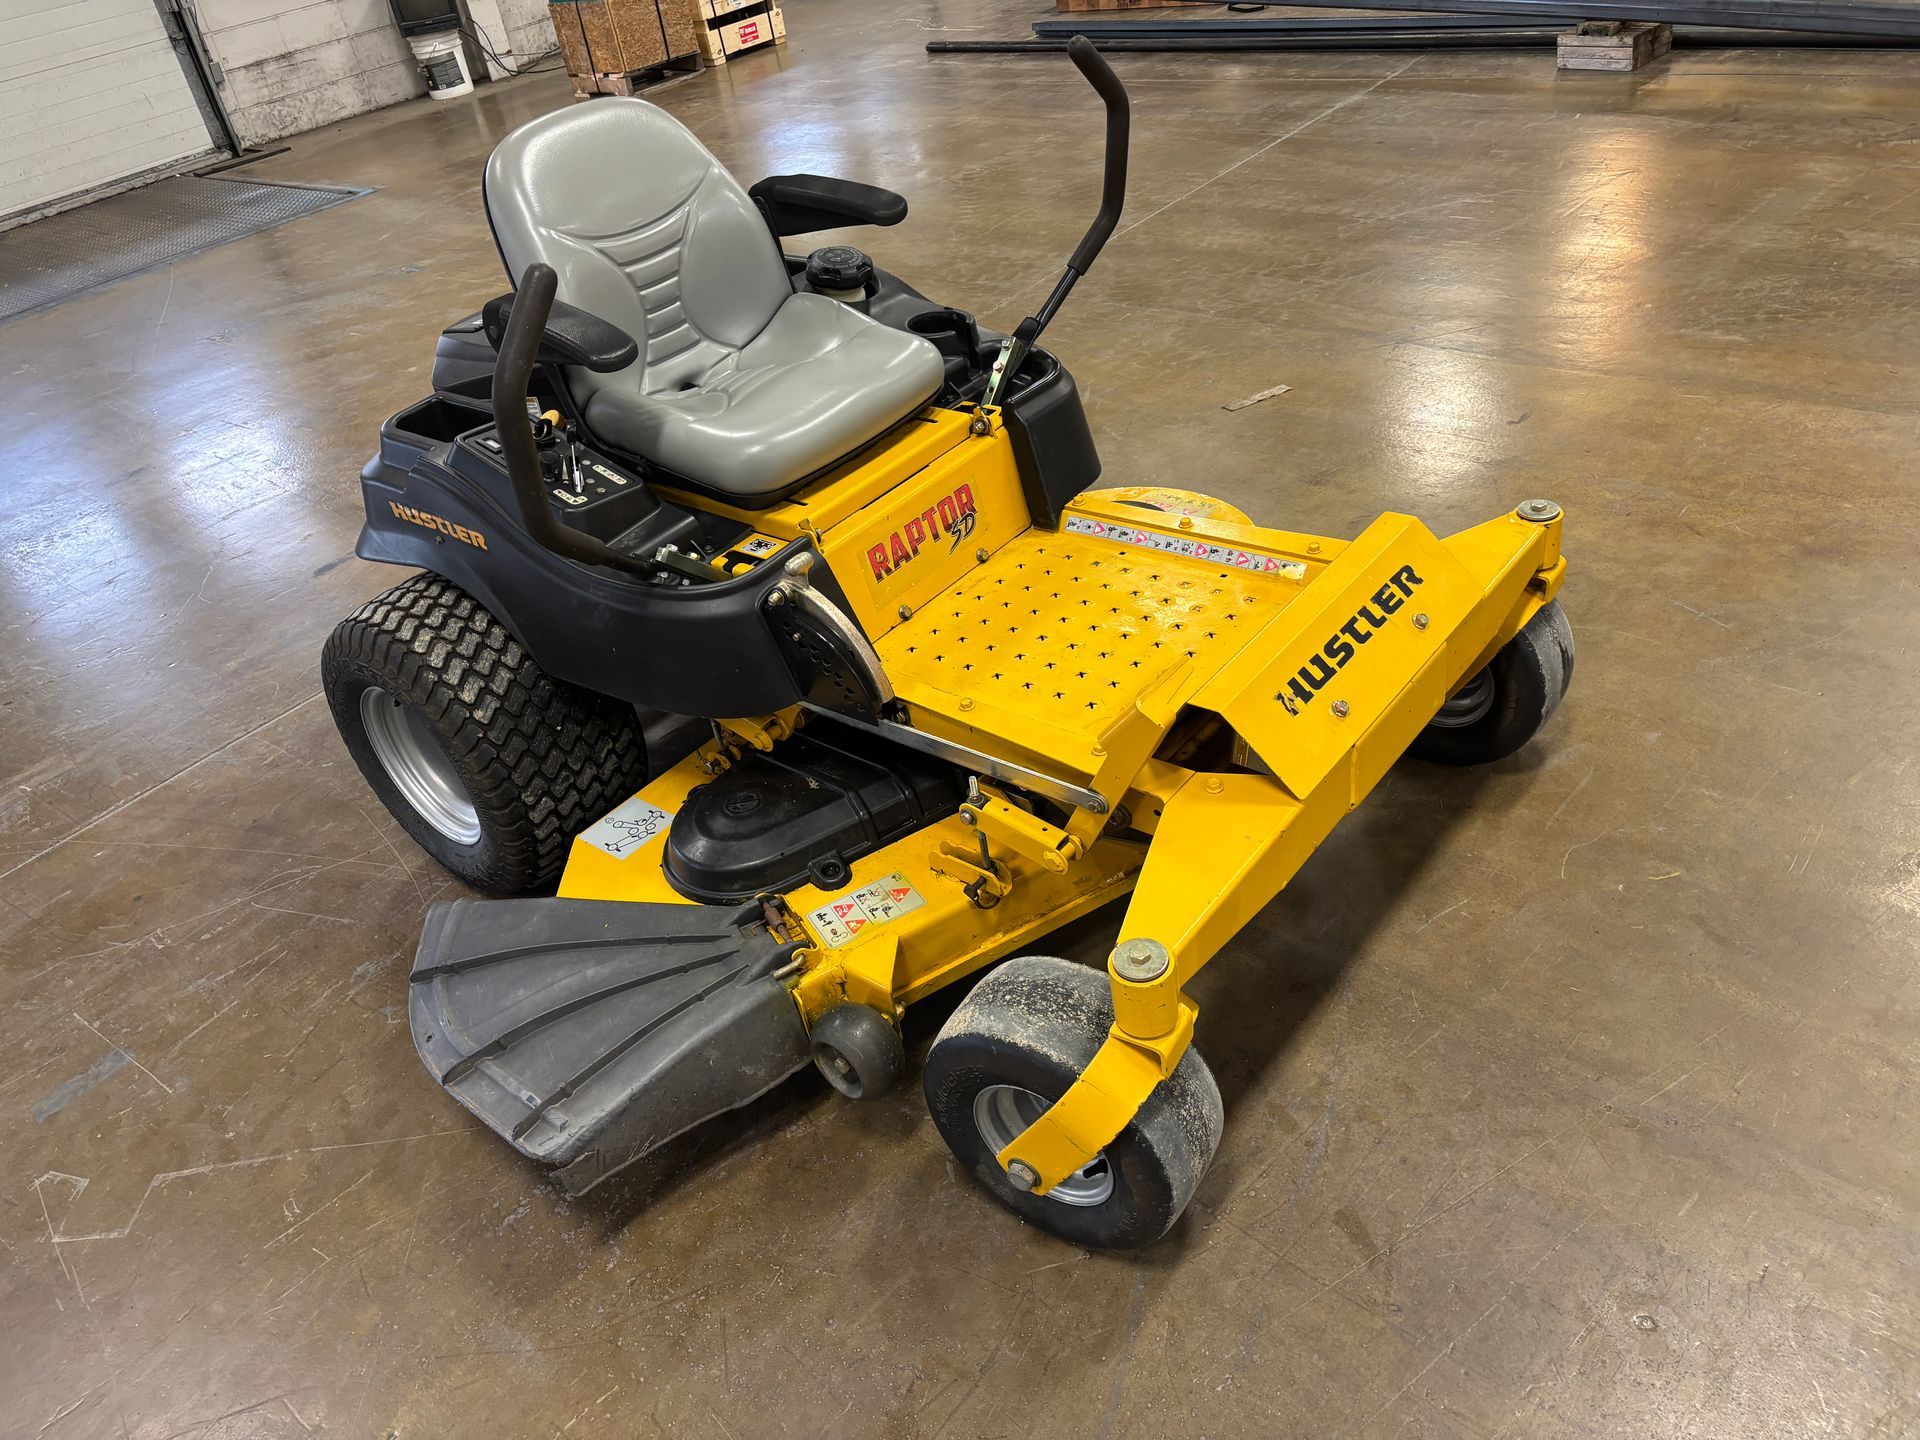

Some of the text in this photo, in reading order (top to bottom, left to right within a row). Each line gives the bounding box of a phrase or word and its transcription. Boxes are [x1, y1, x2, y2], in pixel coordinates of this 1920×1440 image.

[388, 500, 489, 551] HUSTLER
[866, 483, 978, 583] RAPTOR
[949, 511, 977, 555] SD
[1274, 564, 1424, 717] HUSTLER
